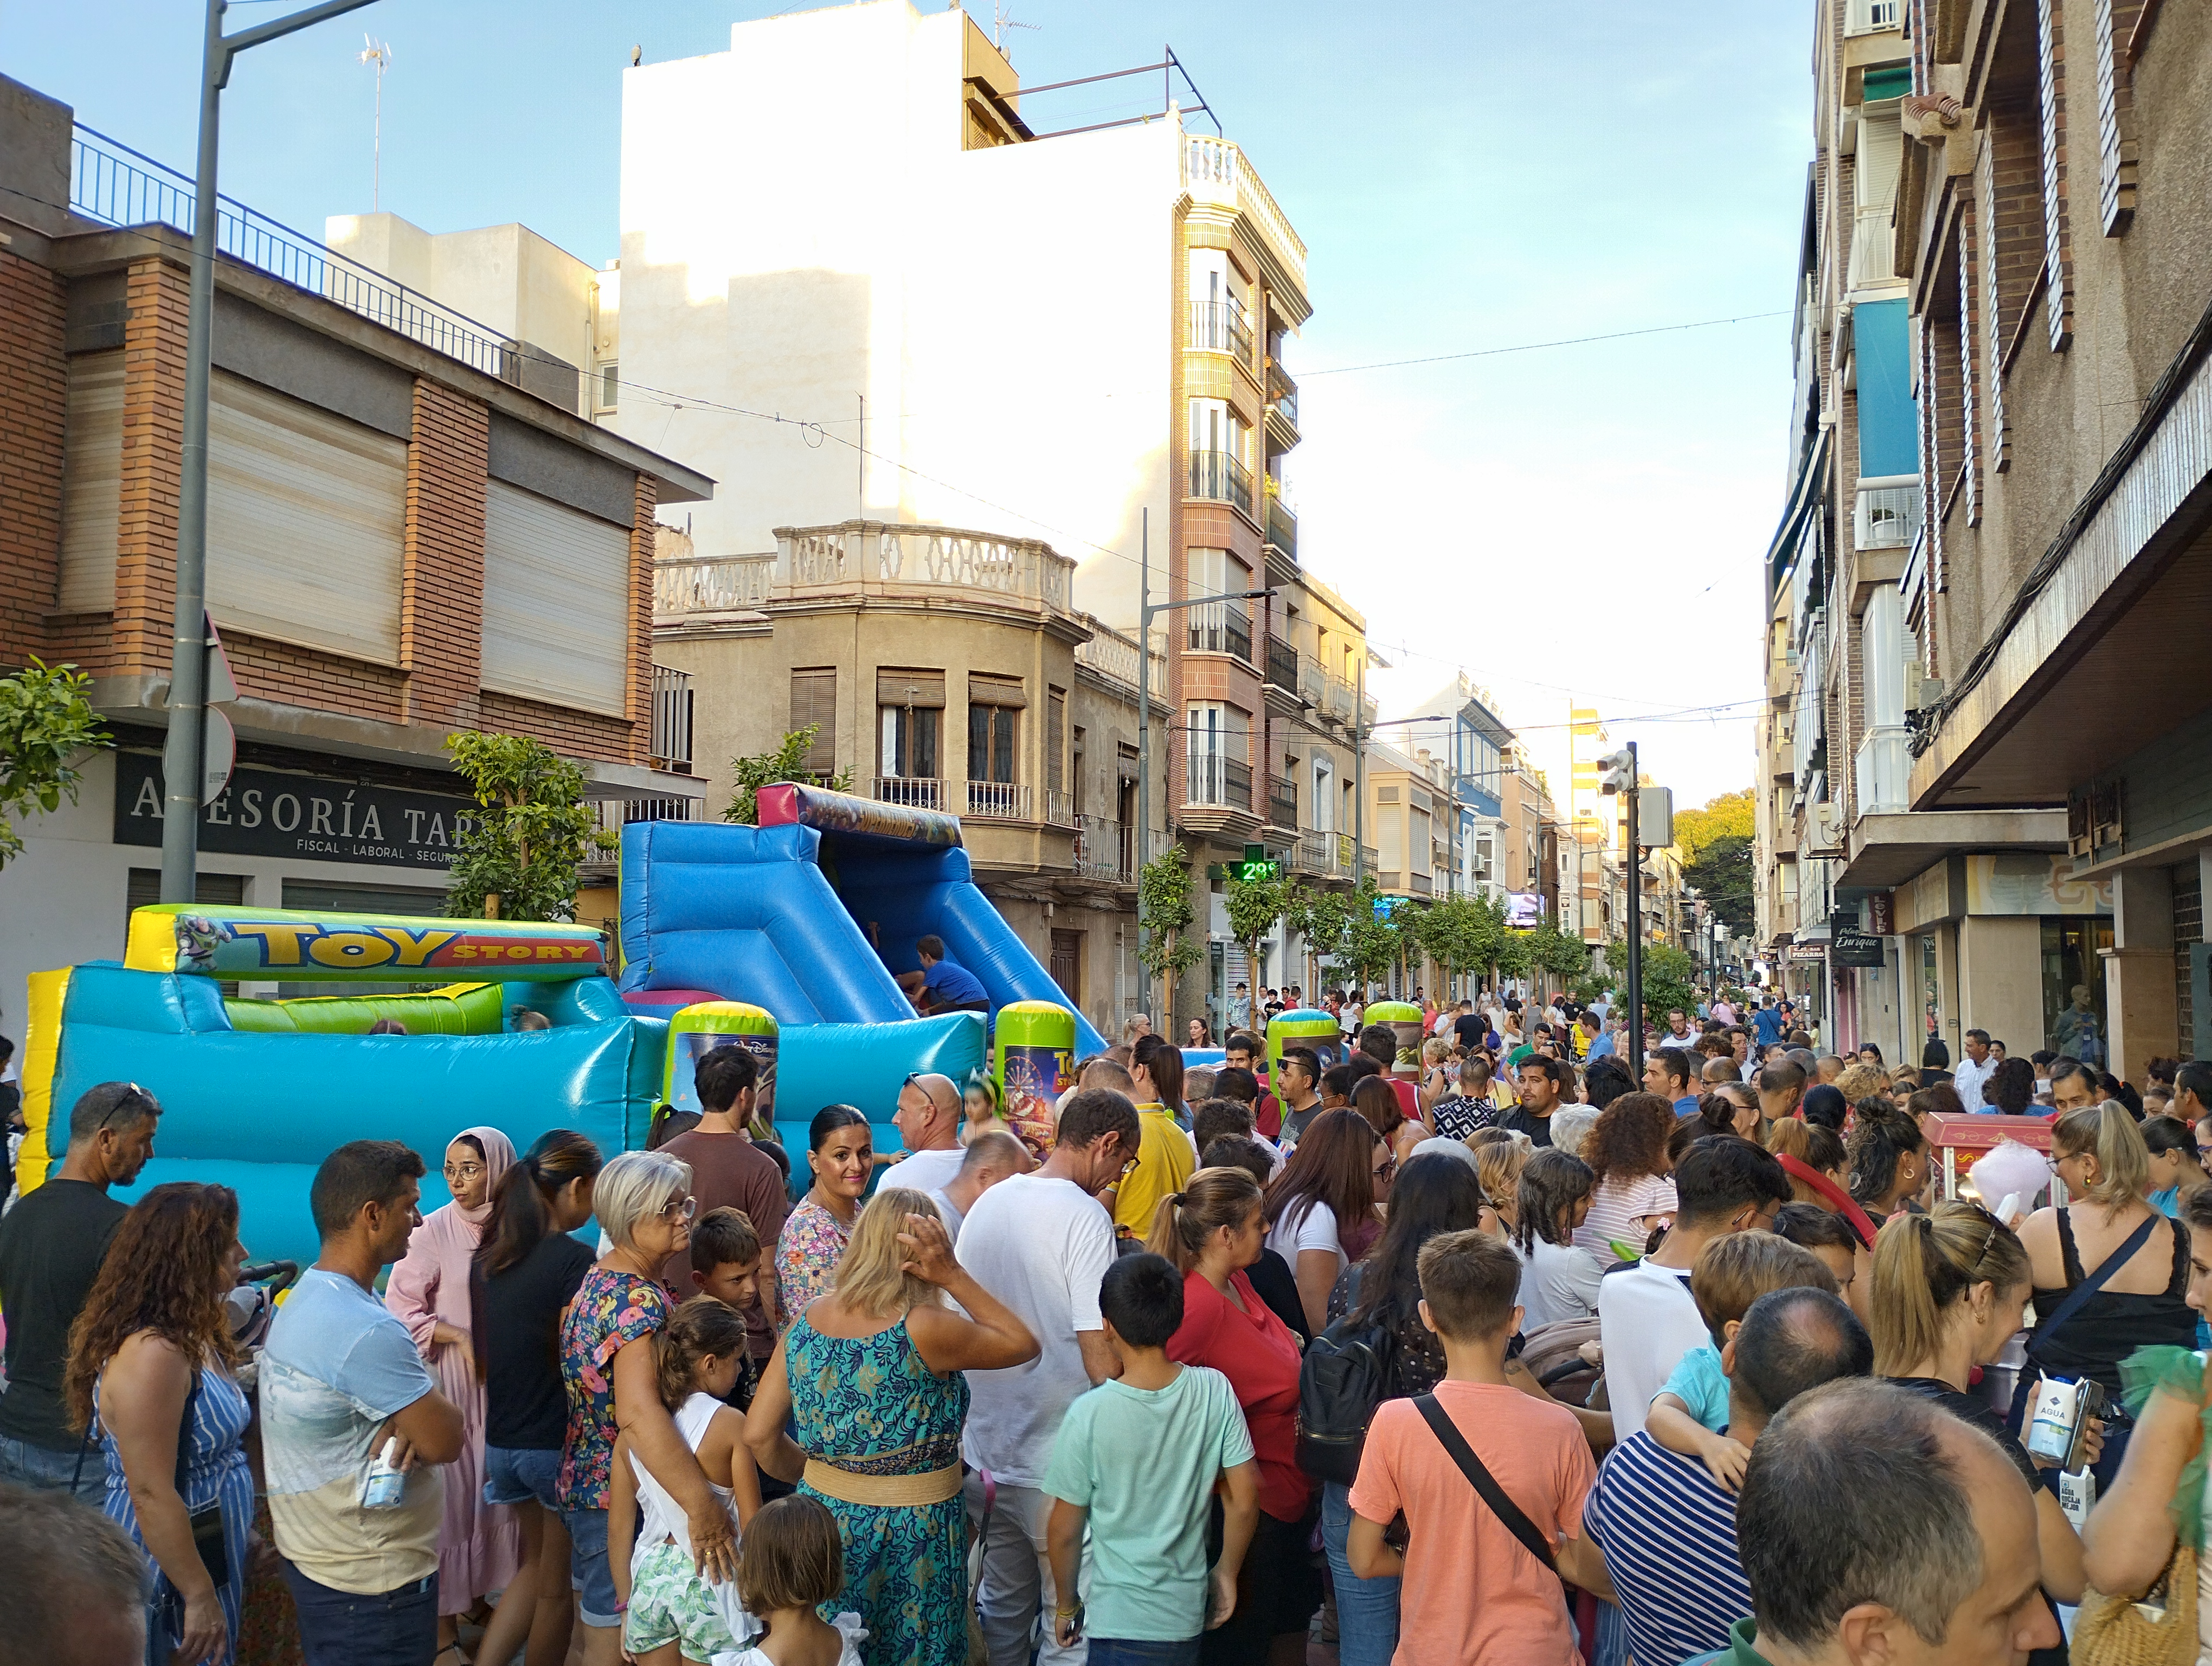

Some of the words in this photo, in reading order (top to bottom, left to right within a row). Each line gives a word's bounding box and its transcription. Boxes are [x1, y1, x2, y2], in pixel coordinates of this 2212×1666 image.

[131, 777, 384, 841] AESORÍA
[297, 839, 339, 854] FISCAL
[352, 844, 404, 859] LABORAL
[232, 924, 458, 967] TOY
[453, 945, 590, 959] STORY
[1835, 936, 1877, 949] Enrique
[1054, 1051, 1074, 1075] TO
[2040, 1407, 2065, 1420] AGUA
[2061, 1488, 2074, 1496] AGUA
[2061, 1502, 2080, 1512] MEJOR
